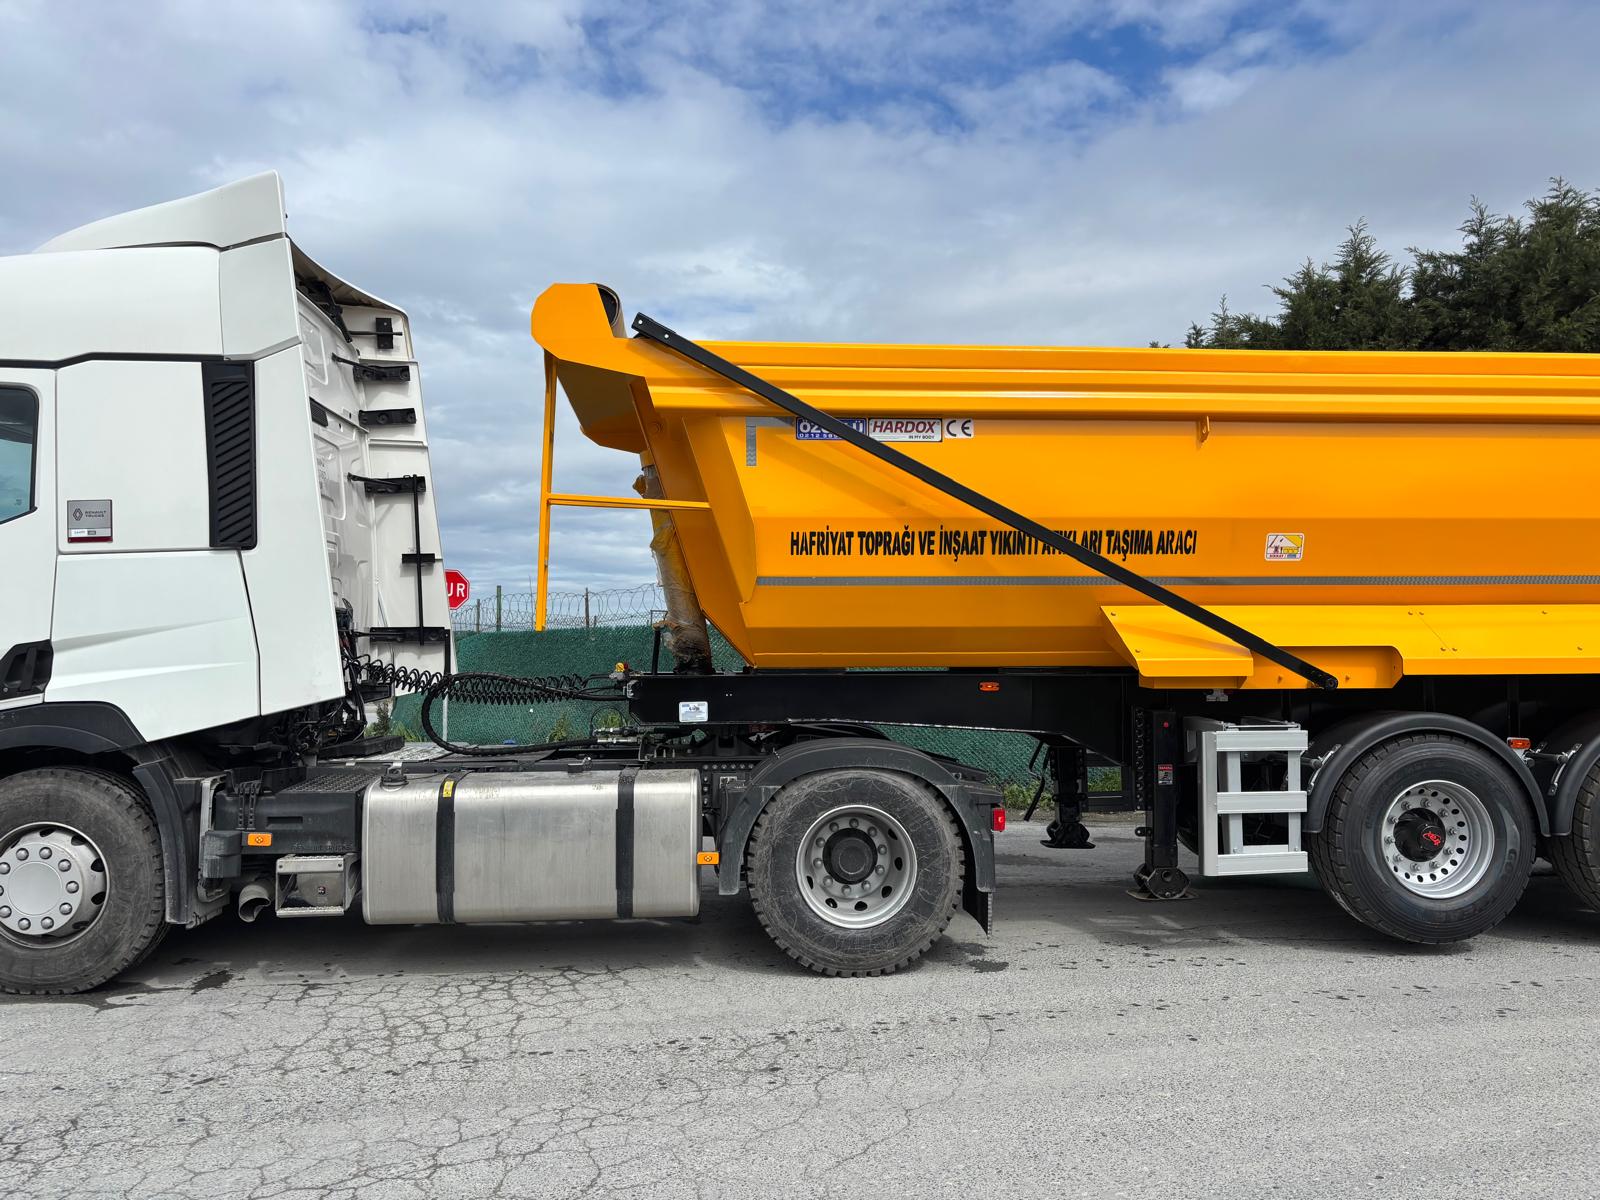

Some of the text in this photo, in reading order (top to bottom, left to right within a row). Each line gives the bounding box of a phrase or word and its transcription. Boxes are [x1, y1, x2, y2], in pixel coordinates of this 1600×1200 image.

[873, 421, 936, 433] HARDOX
[790, 525, 854, 556] HAFRİYAT
[858, 525, 915, 556] TOPRAĞI
[918, 530, 935, 555] VE
[939, 525, 987, 562] İNŞAAT
[1106, 530, 1153, 562] TAŞIMA
[1156, 530, 1197, 554] ARACI
[448, 582, 465, 597] UR
